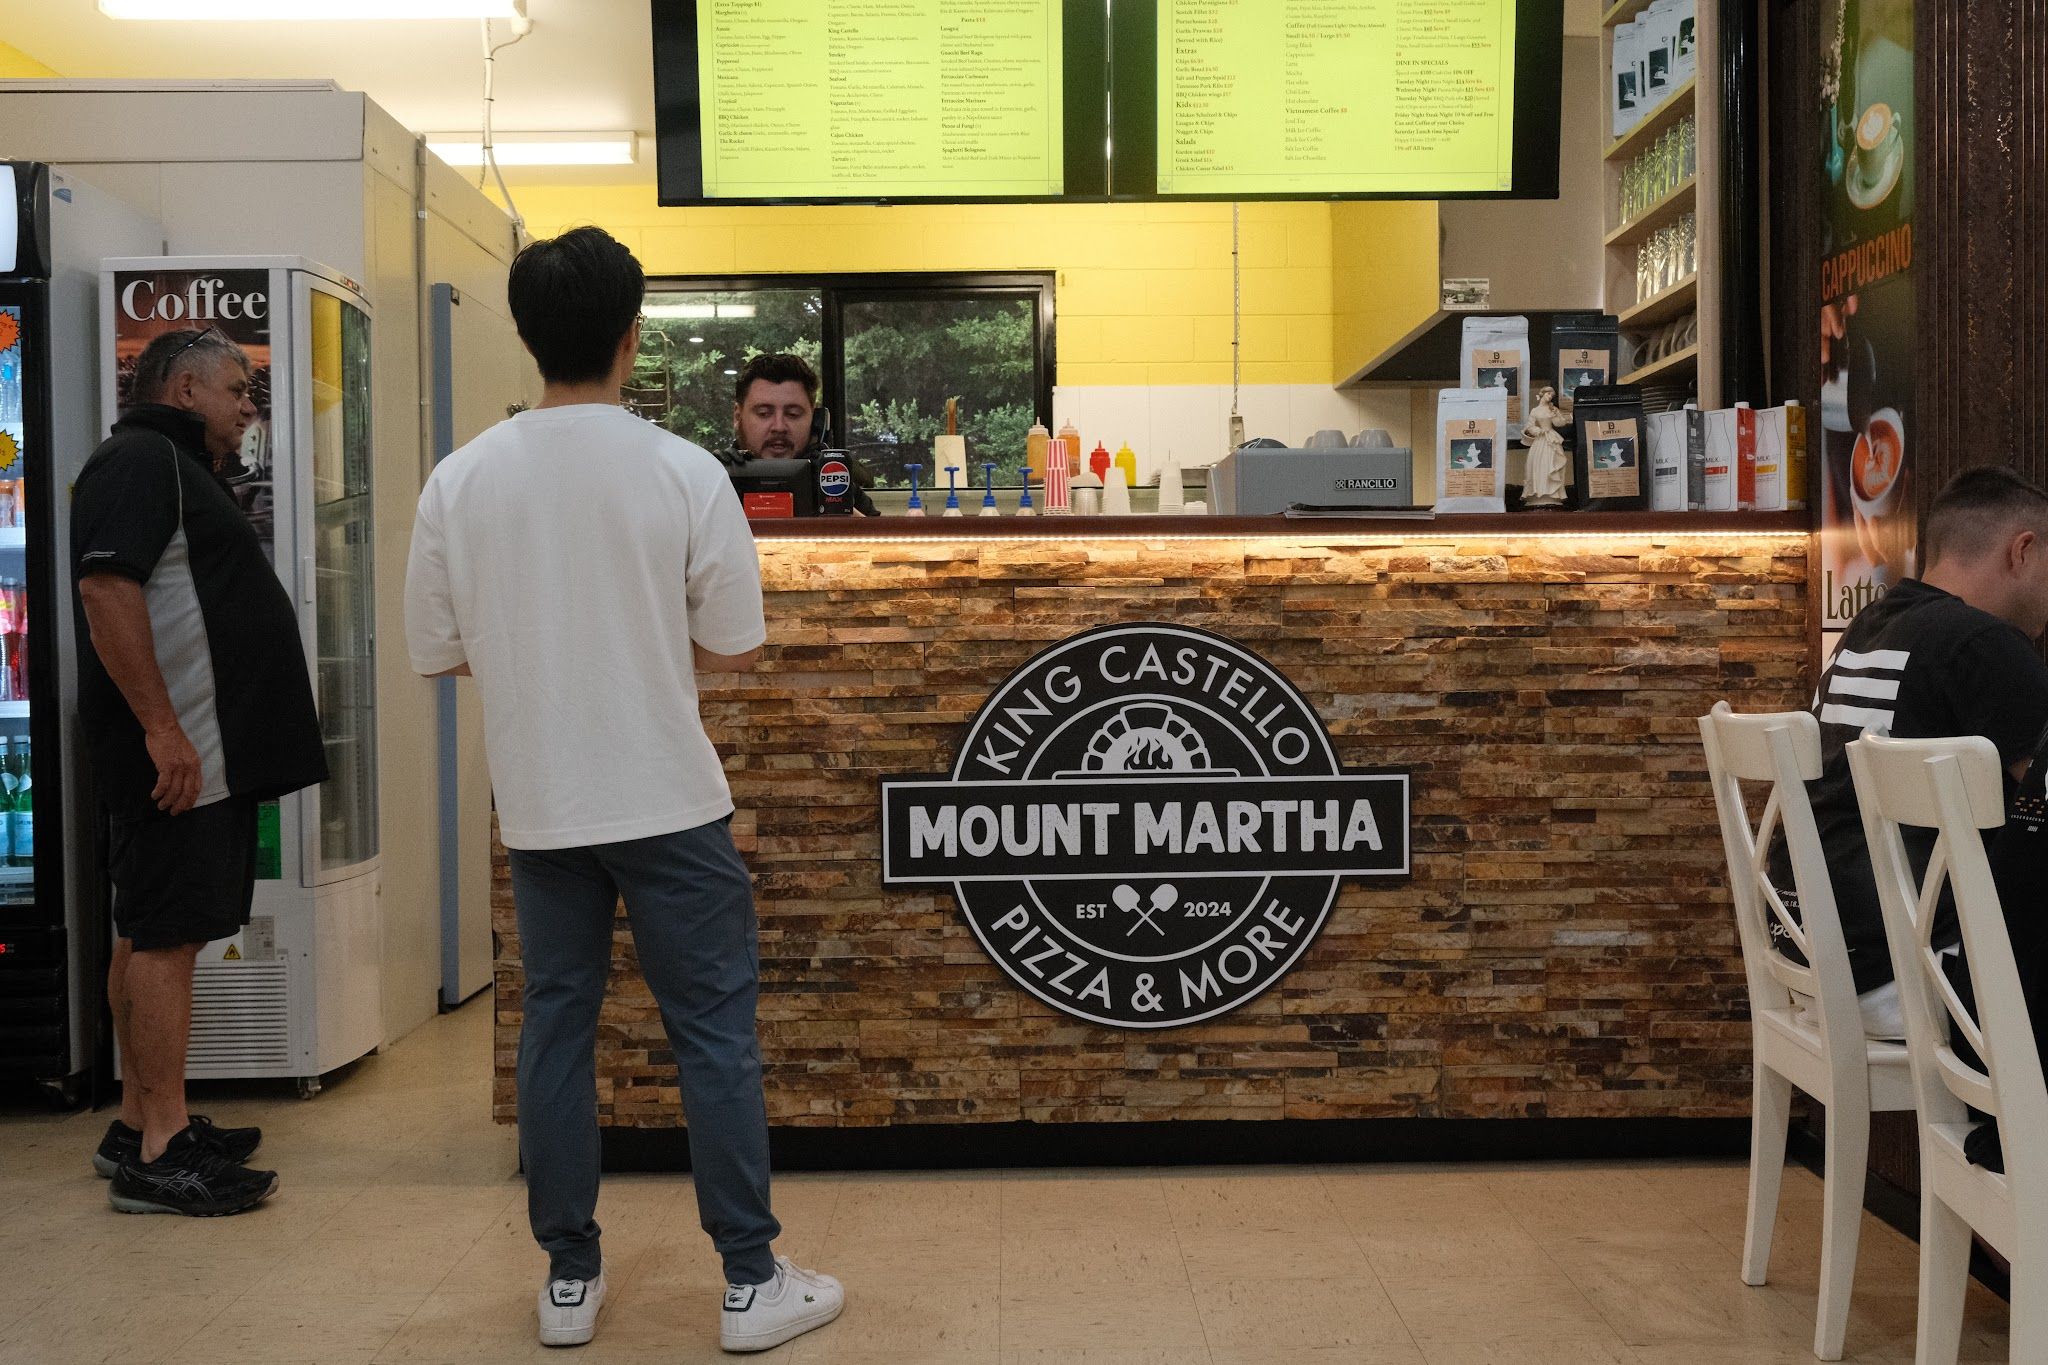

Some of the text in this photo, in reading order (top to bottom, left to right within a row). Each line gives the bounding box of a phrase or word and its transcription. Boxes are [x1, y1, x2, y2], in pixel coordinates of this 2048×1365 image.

[1822, 223, 1912, 300] CAPPUCCINO
[120, 277, 267, 321] Coffee
[821, 475, 849, 483] PEPSI
[1348, 479, 1394, 488] RANCILIO
[976, 642, 1310, 775] KING CASTELLO
[909, 798, 1383, 858] MOUNT MARTHA
[1076, 901, 1232, 919] EST 2024
[990, 898, 1306, 1012] PIZZA & MORE
